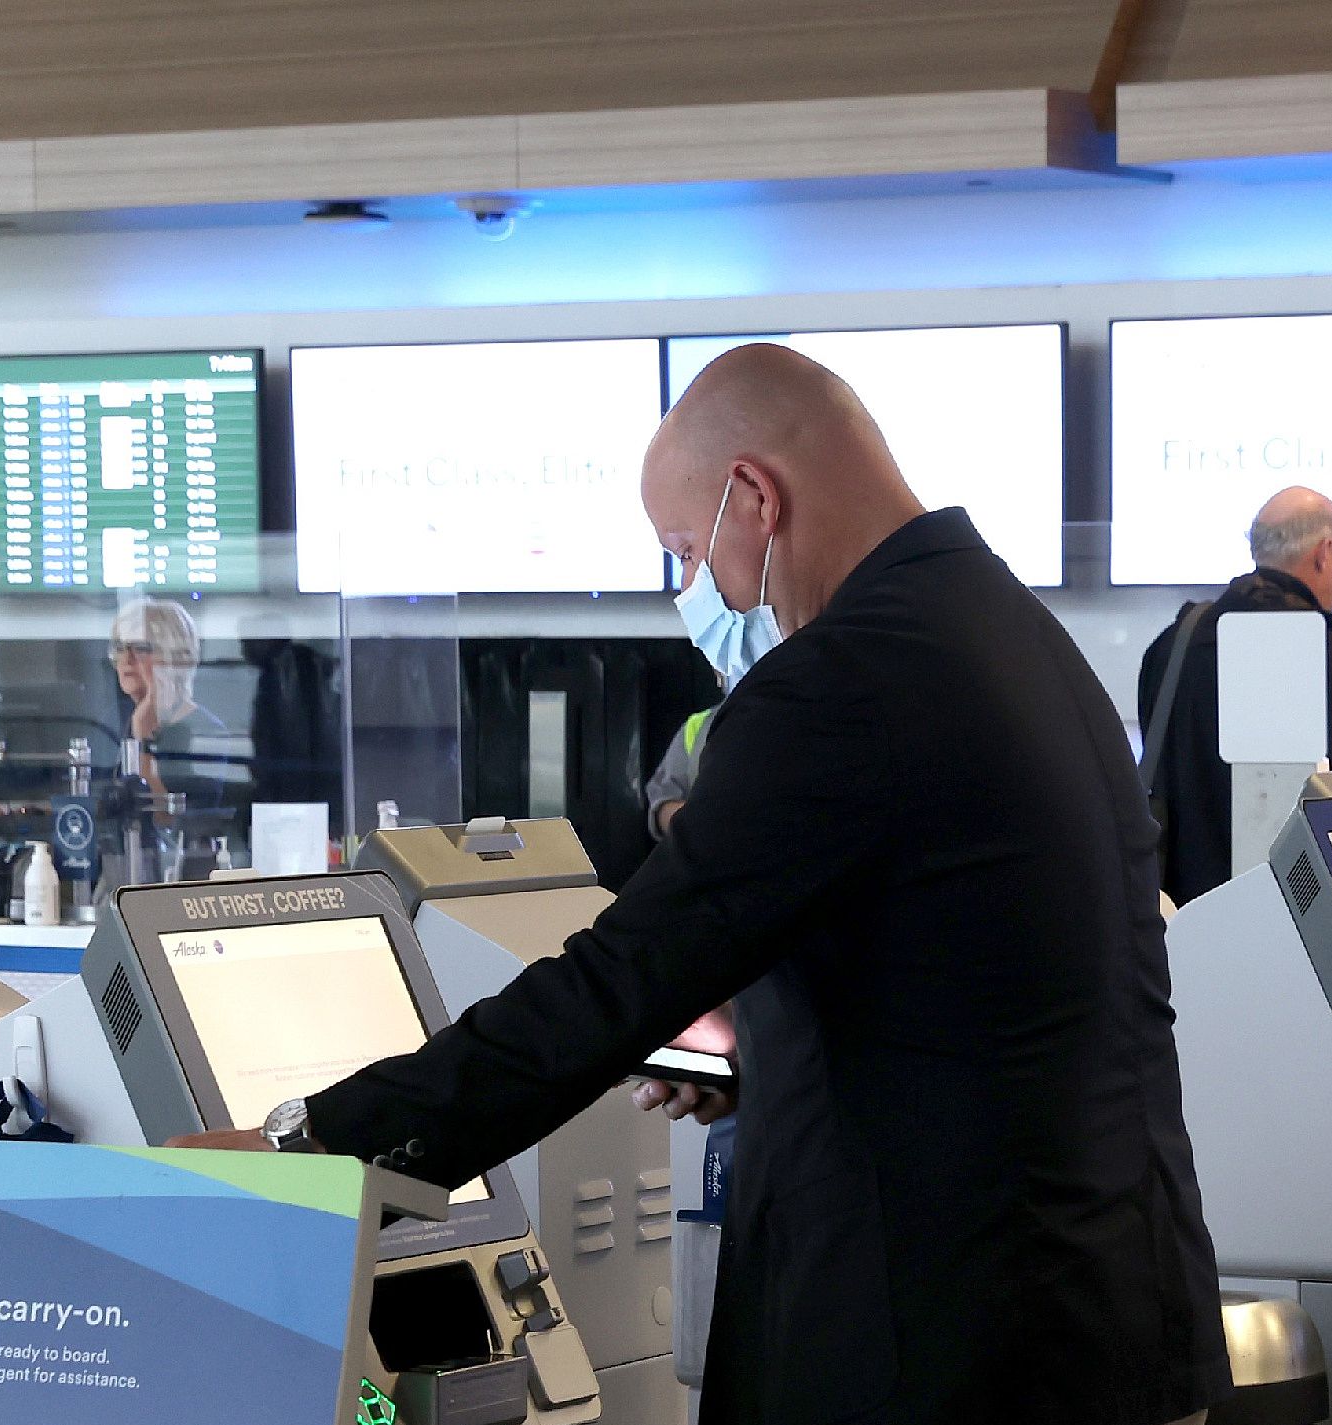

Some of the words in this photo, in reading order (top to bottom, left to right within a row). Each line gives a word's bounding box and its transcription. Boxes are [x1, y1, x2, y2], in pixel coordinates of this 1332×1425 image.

[1164, 438, 1246, 471] First
[339, 458, 411, 487] First
[182, 896, 218, 920] BUT
[218, 892, 277, 919] FIRST,
[273, 887, 347, 914] COFFEE?
[172, 940, 208, 958] Alaska
[43, 1346, 59, 1362] to
[61, 1345, 110, 1365] board.
[33, 1366, 56, 1384] for
[57, 1369, 140, 1389] assistance.
